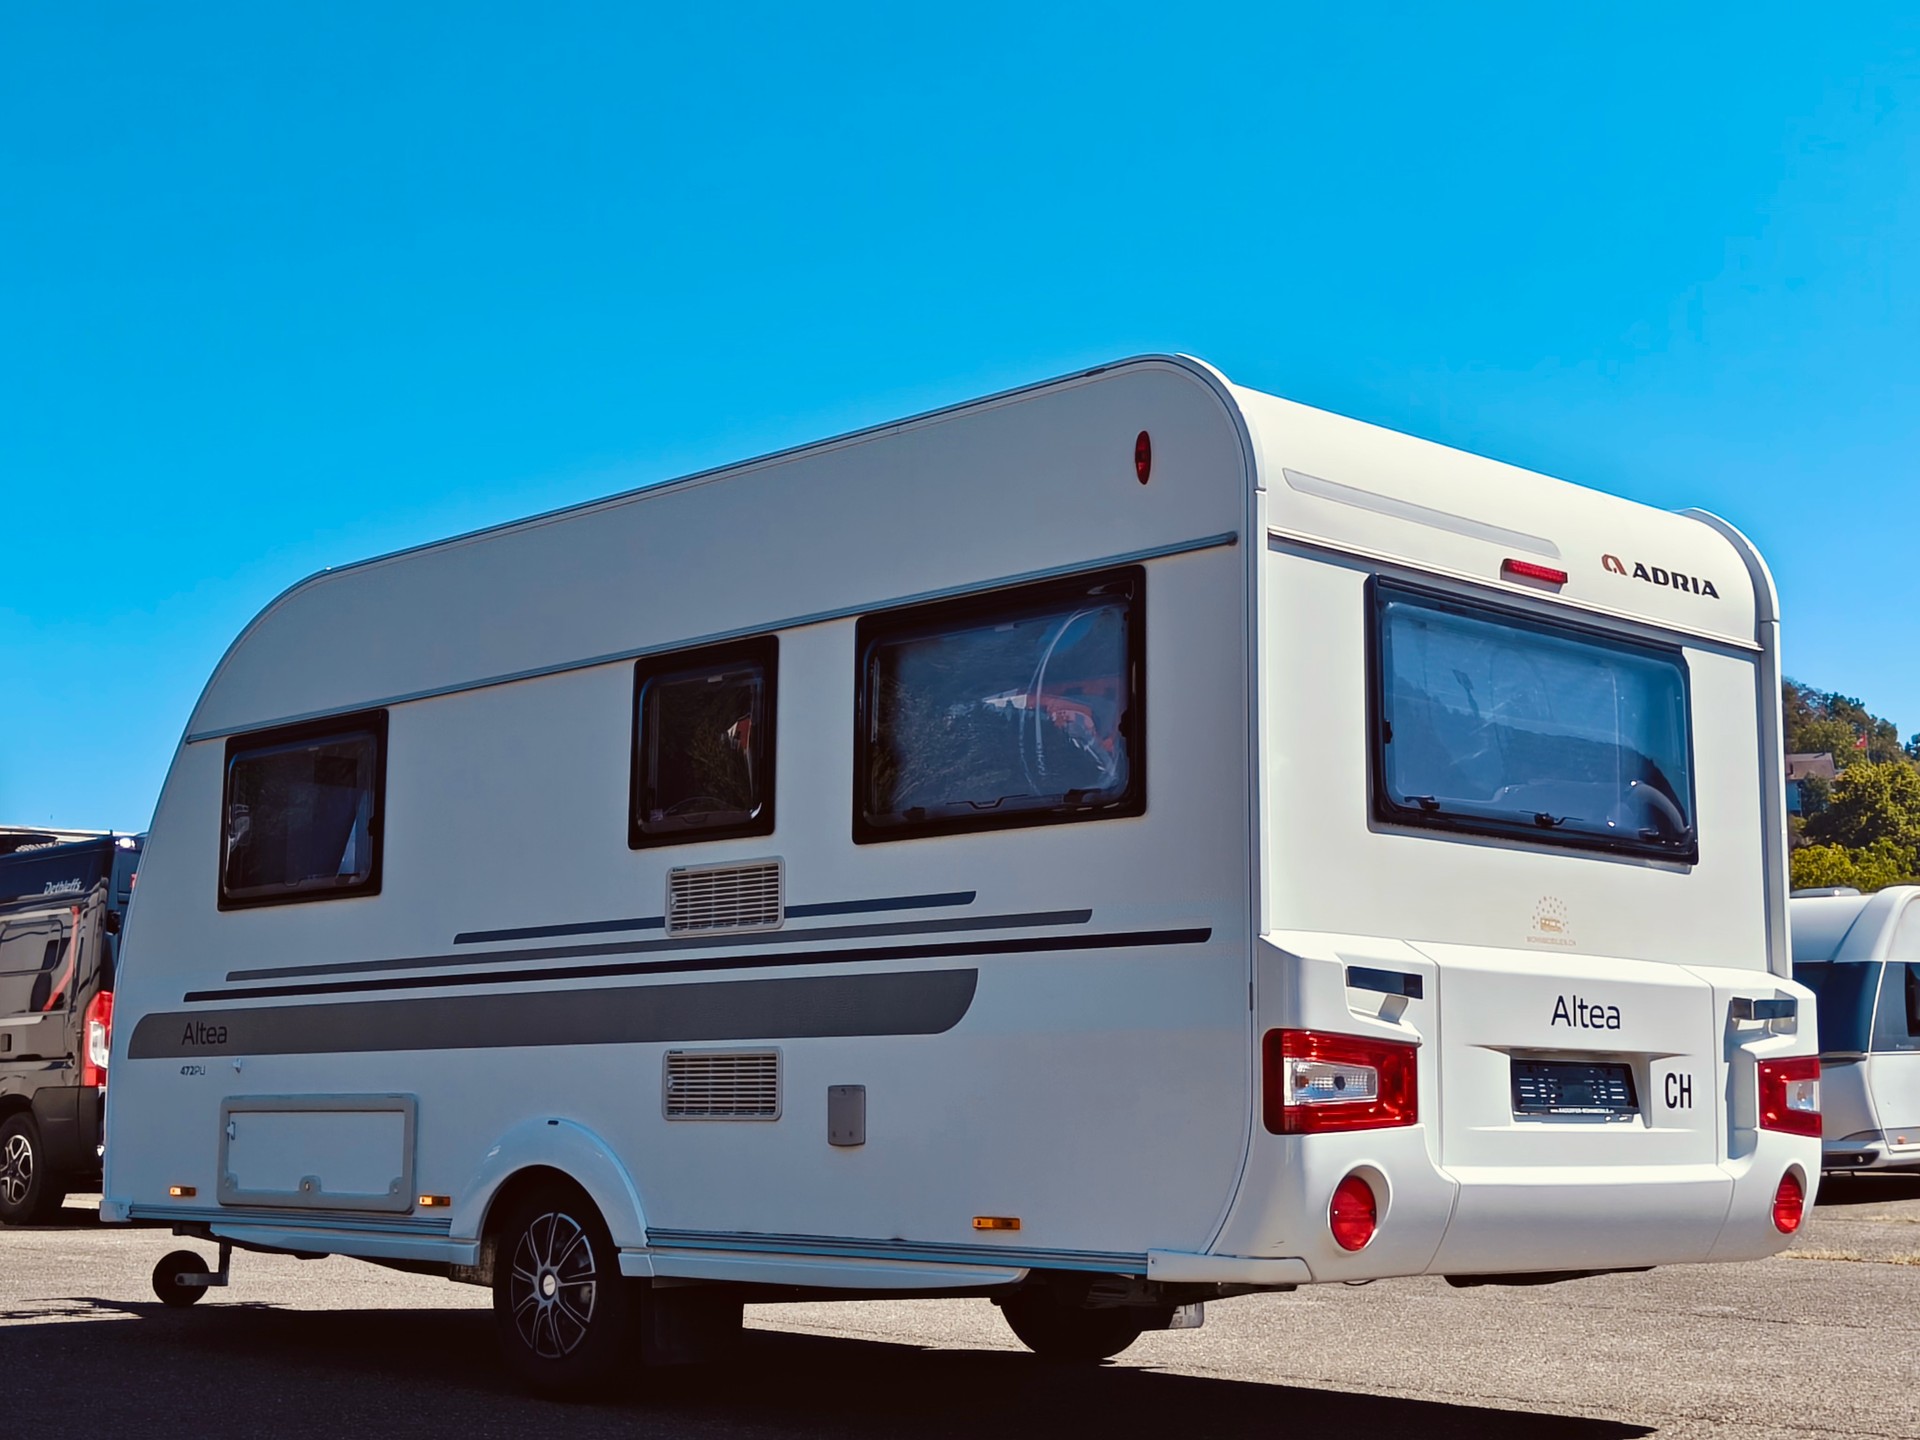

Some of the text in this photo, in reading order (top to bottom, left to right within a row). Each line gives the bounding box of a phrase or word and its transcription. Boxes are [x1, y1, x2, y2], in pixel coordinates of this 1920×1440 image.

[1632, 562, 1720, 600] ADRIA
[1550, 994, 1622, 1030] Altea
[181, 1021, 228, 1046] Altea
[180, 1065, 206, 1076] 472PU
[1664, 1072, 1692, 1109] CH
